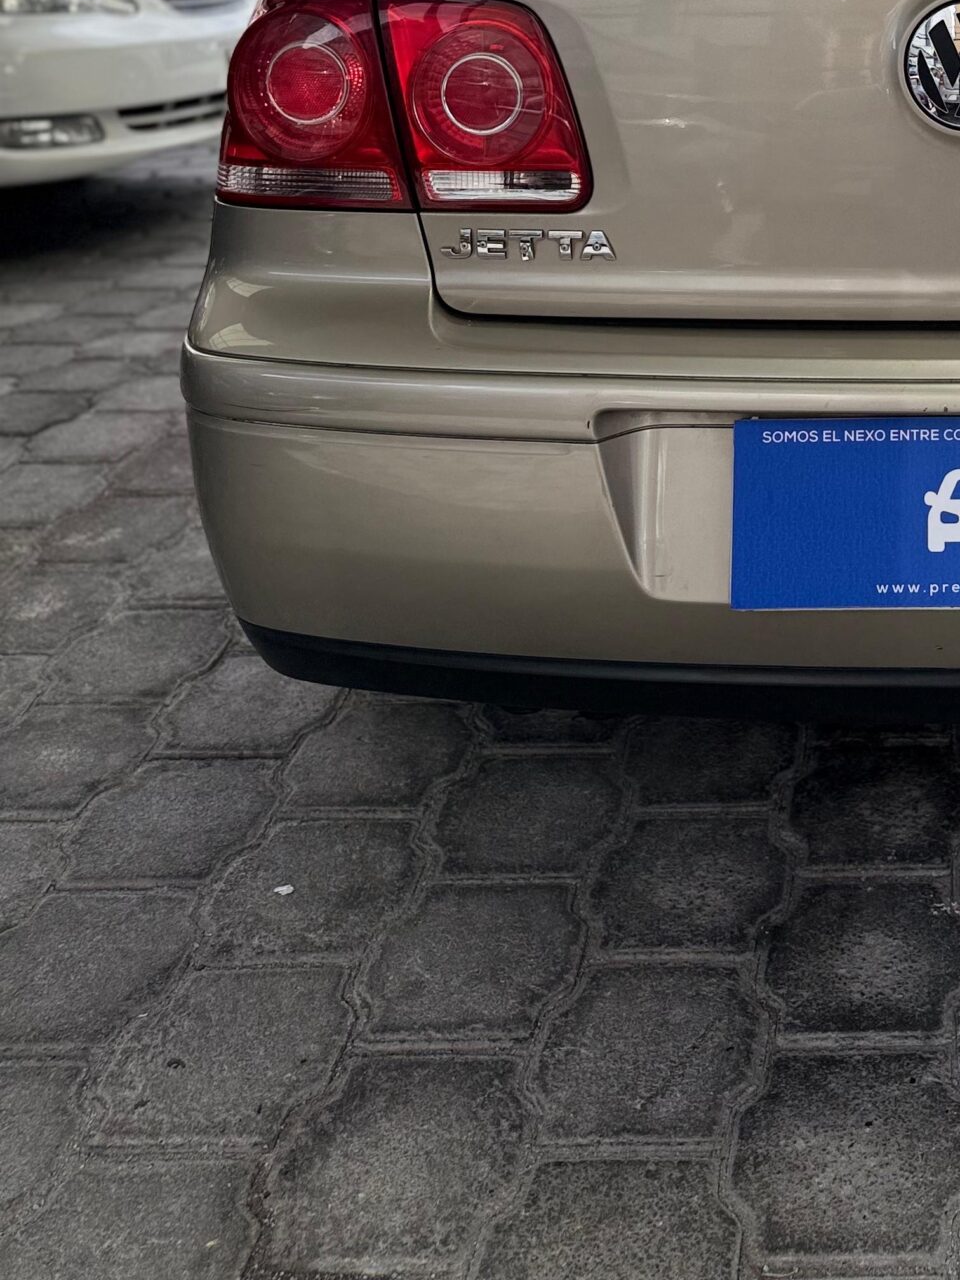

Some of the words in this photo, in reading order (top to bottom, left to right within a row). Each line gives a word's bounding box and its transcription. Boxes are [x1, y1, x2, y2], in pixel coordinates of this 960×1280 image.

[440, 228, 617, 261] JETTA
[762, 430, 818, 443] SOMOS
[822, 430, 841, 442] EL
[844, 429, 886, 442] NEXO
[889, 429, 940, 441] ENTRE
